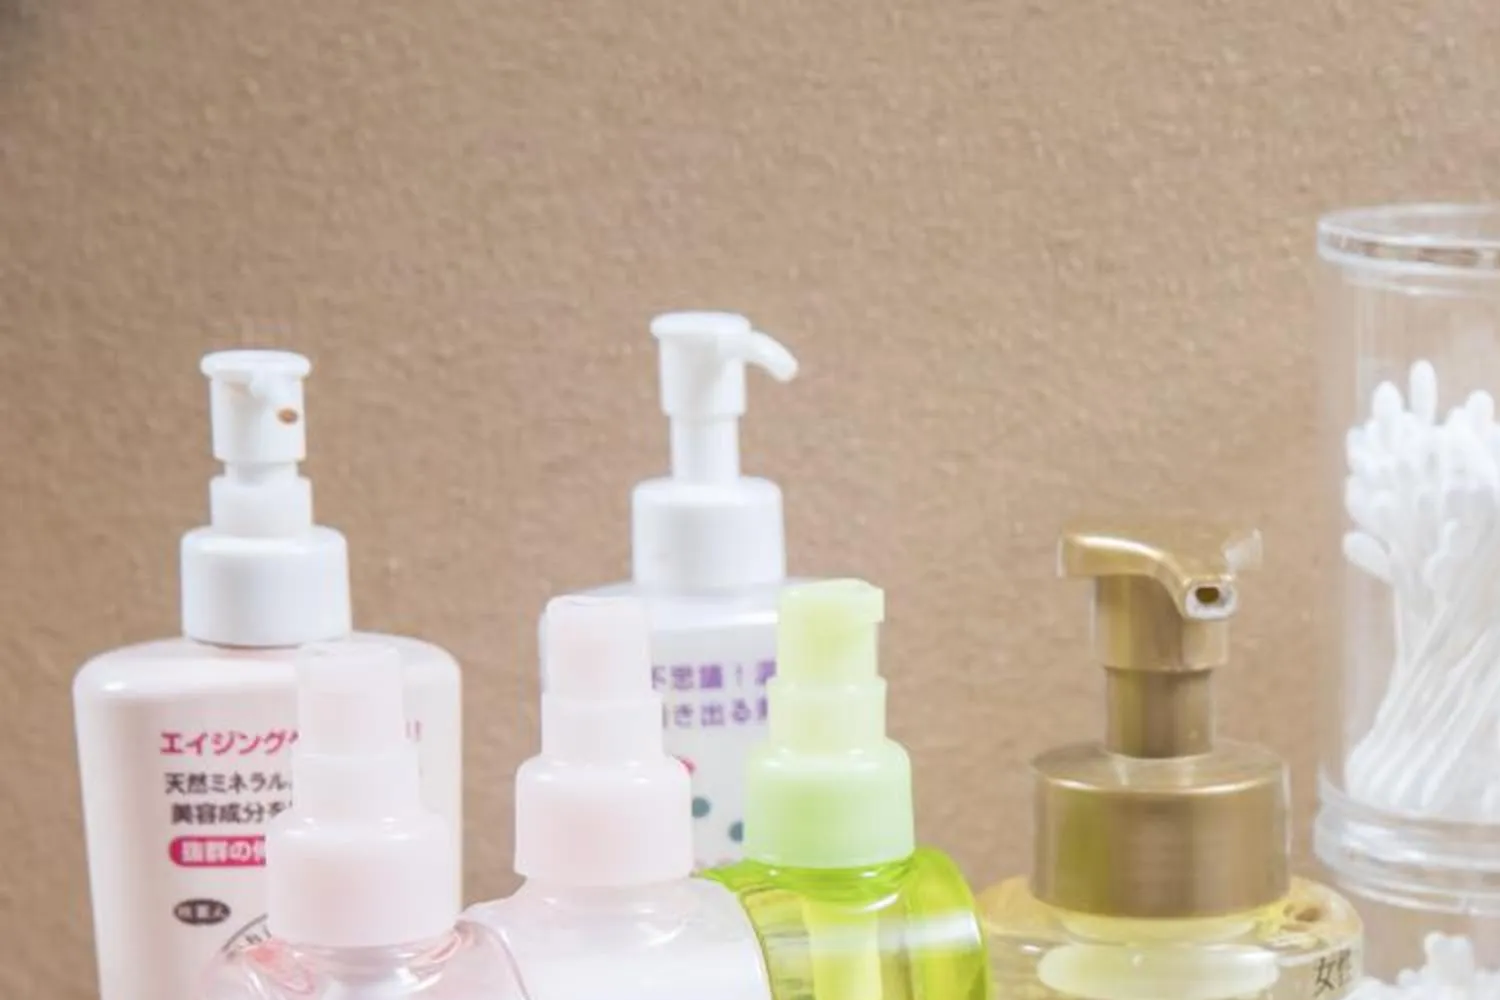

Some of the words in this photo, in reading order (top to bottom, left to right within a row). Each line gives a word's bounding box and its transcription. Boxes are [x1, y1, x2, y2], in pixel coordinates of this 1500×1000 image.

[160, 729, 299, 757] エイジング
[164, 771, 292, 796] 天然ミネラル
